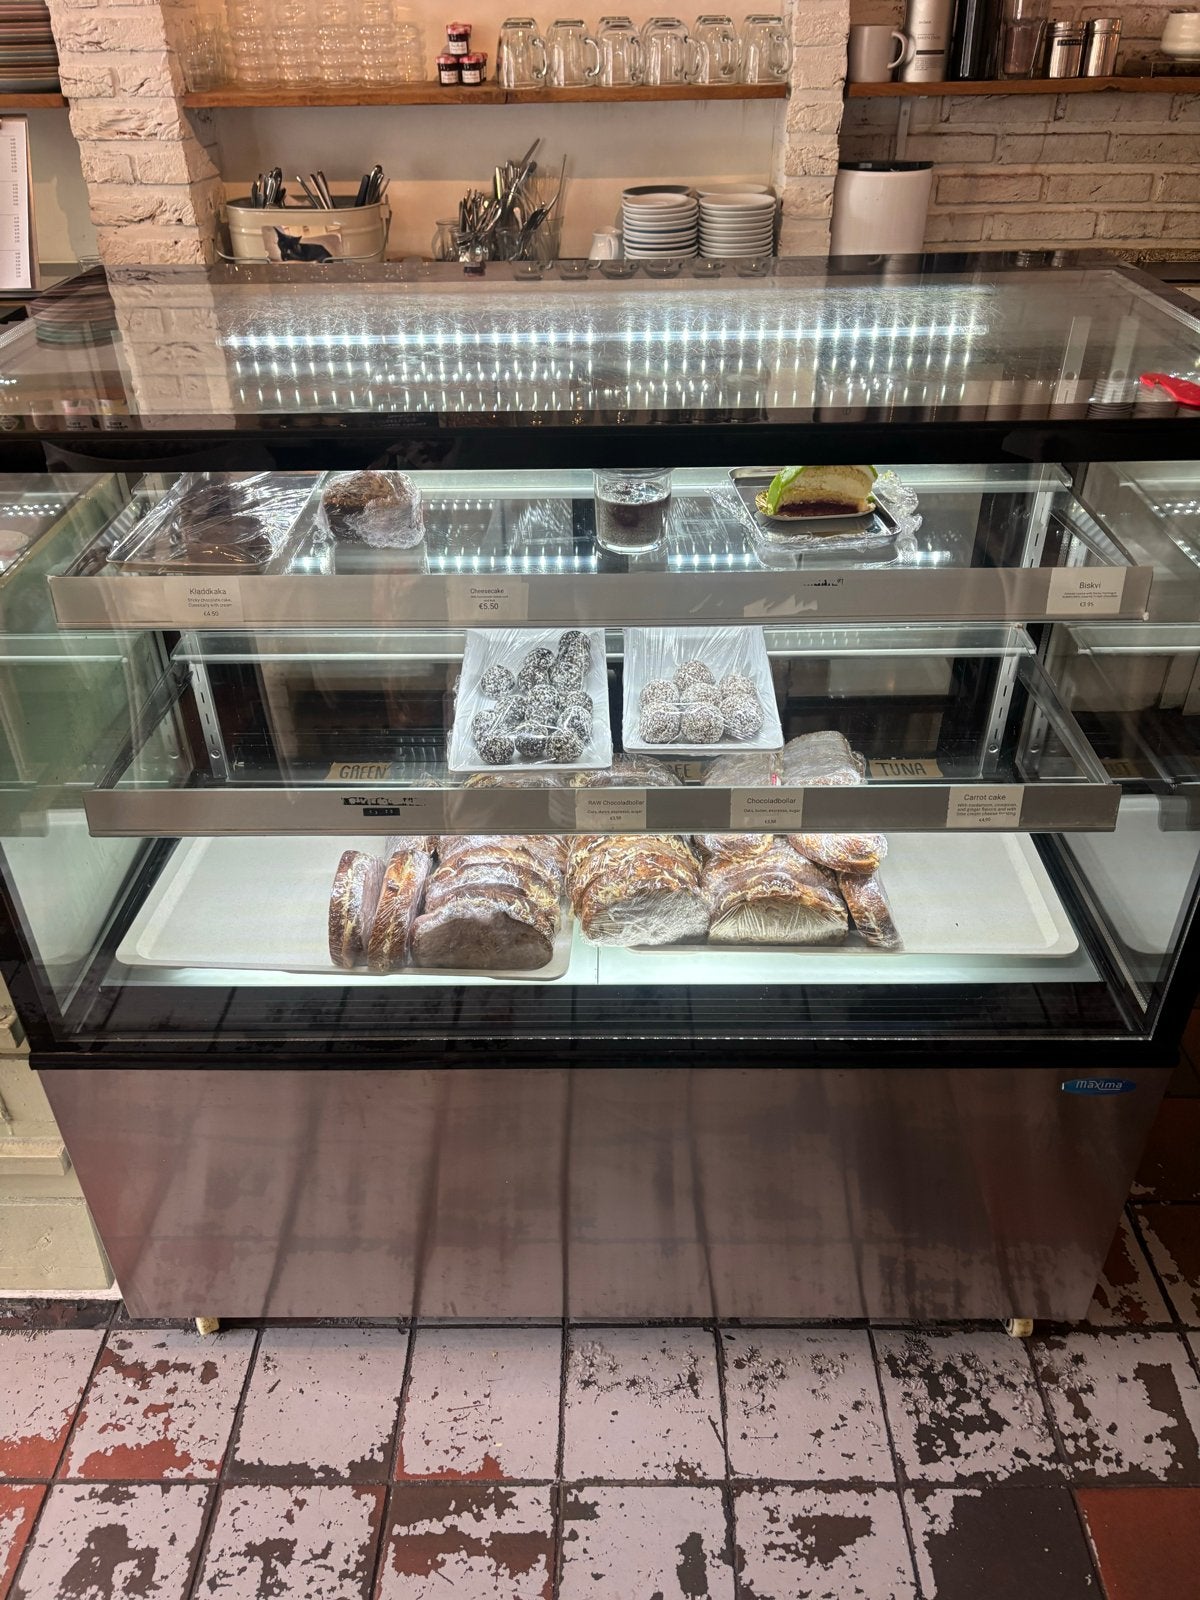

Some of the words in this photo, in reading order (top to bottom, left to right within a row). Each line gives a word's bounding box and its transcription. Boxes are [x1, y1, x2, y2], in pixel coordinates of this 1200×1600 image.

[1079, 581, 1101, 589] Biskvi
[189, 587, 227, 595] Kladdkaka
[340, 765, 387, 779] GREEN
[874, 762, 927, 776] TUNA
